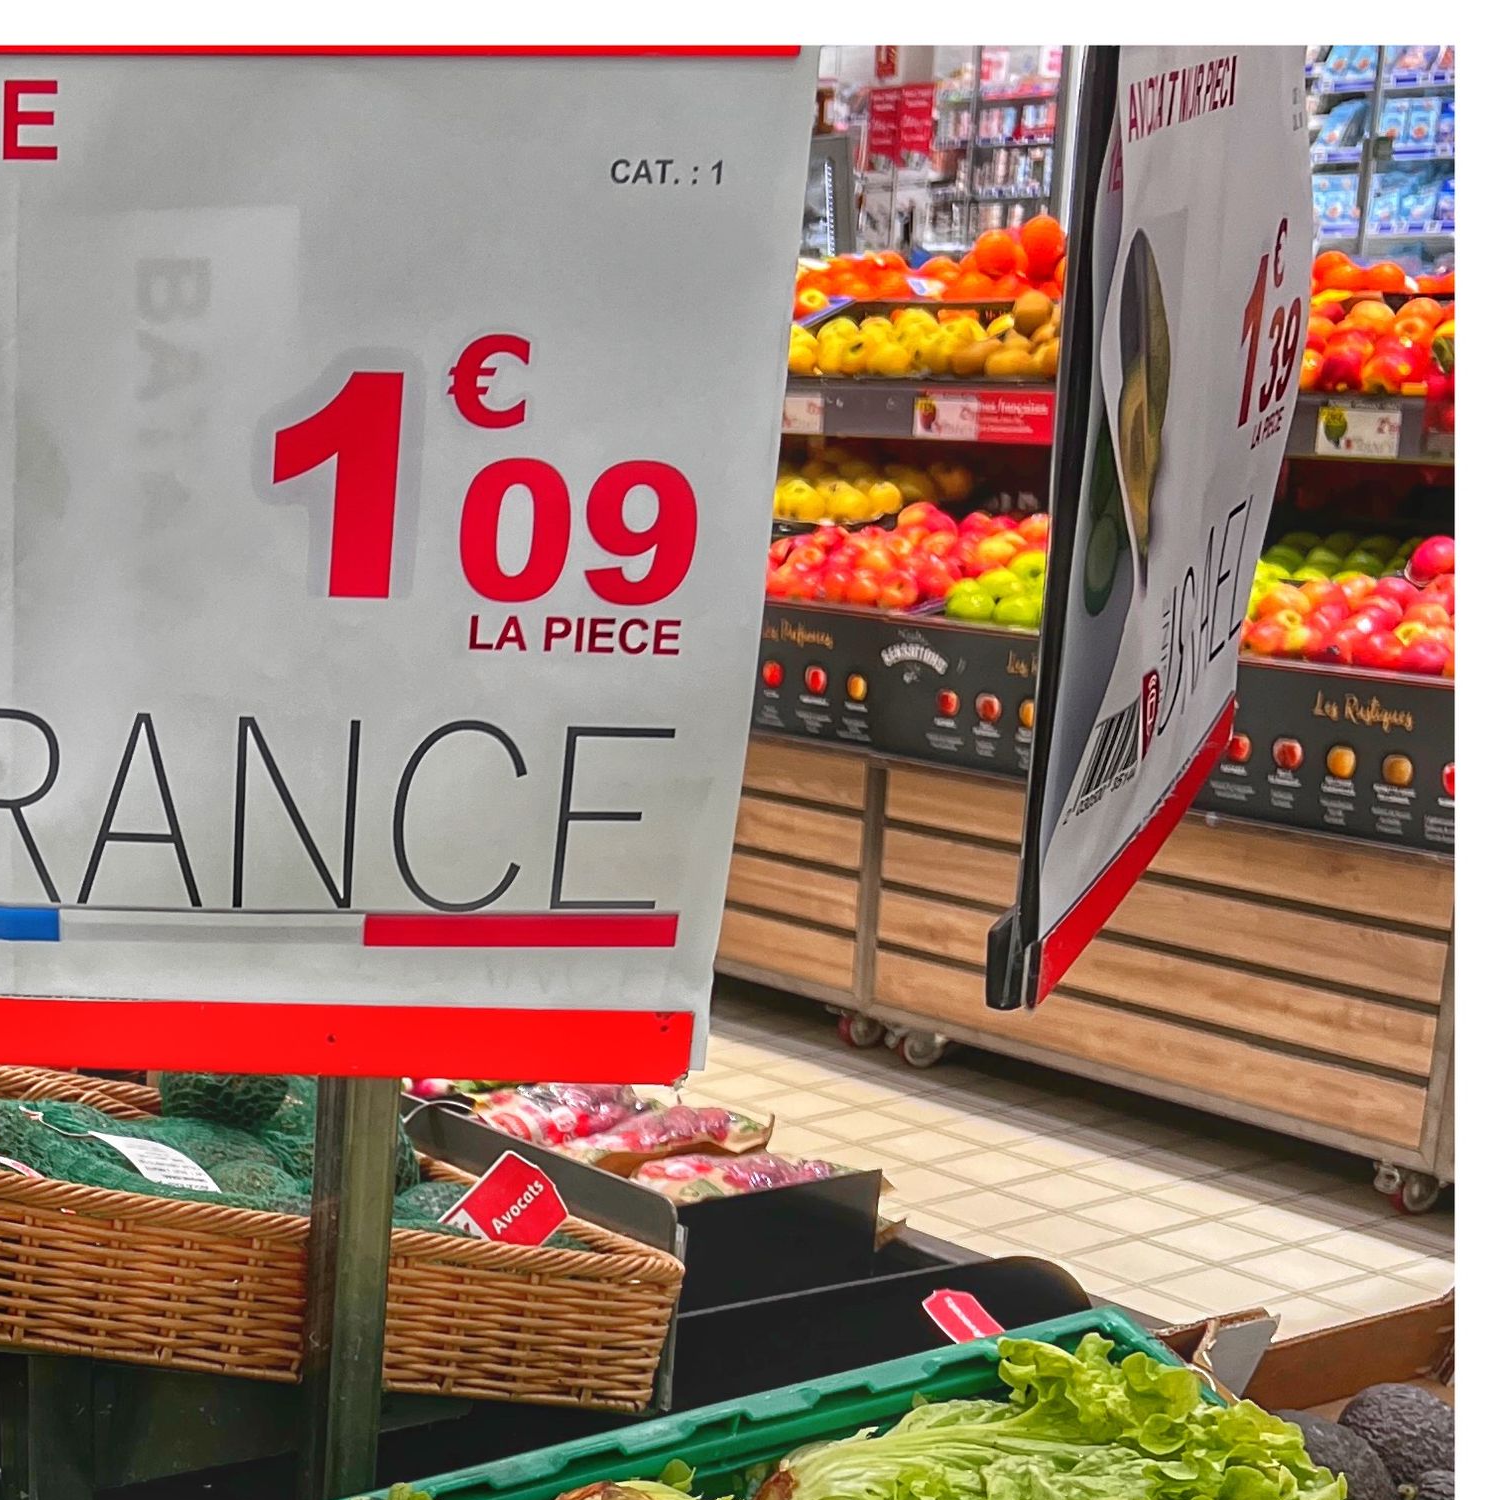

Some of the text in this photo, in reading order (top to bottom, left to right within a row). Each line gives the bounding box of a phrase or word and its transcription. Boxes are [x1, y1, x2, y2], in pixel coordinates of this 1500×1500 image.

[610, 158, 681, 186] CAT.
[711, 159, 724, 186] 1
[272, 371, 405, 600] 1
[458, 456, 700, 607] 09
[469, 615, 681, 656] LA PIECE
[1312, 690, 1339, 721] Les
[491, 1180, 545, 1235] Avocats
